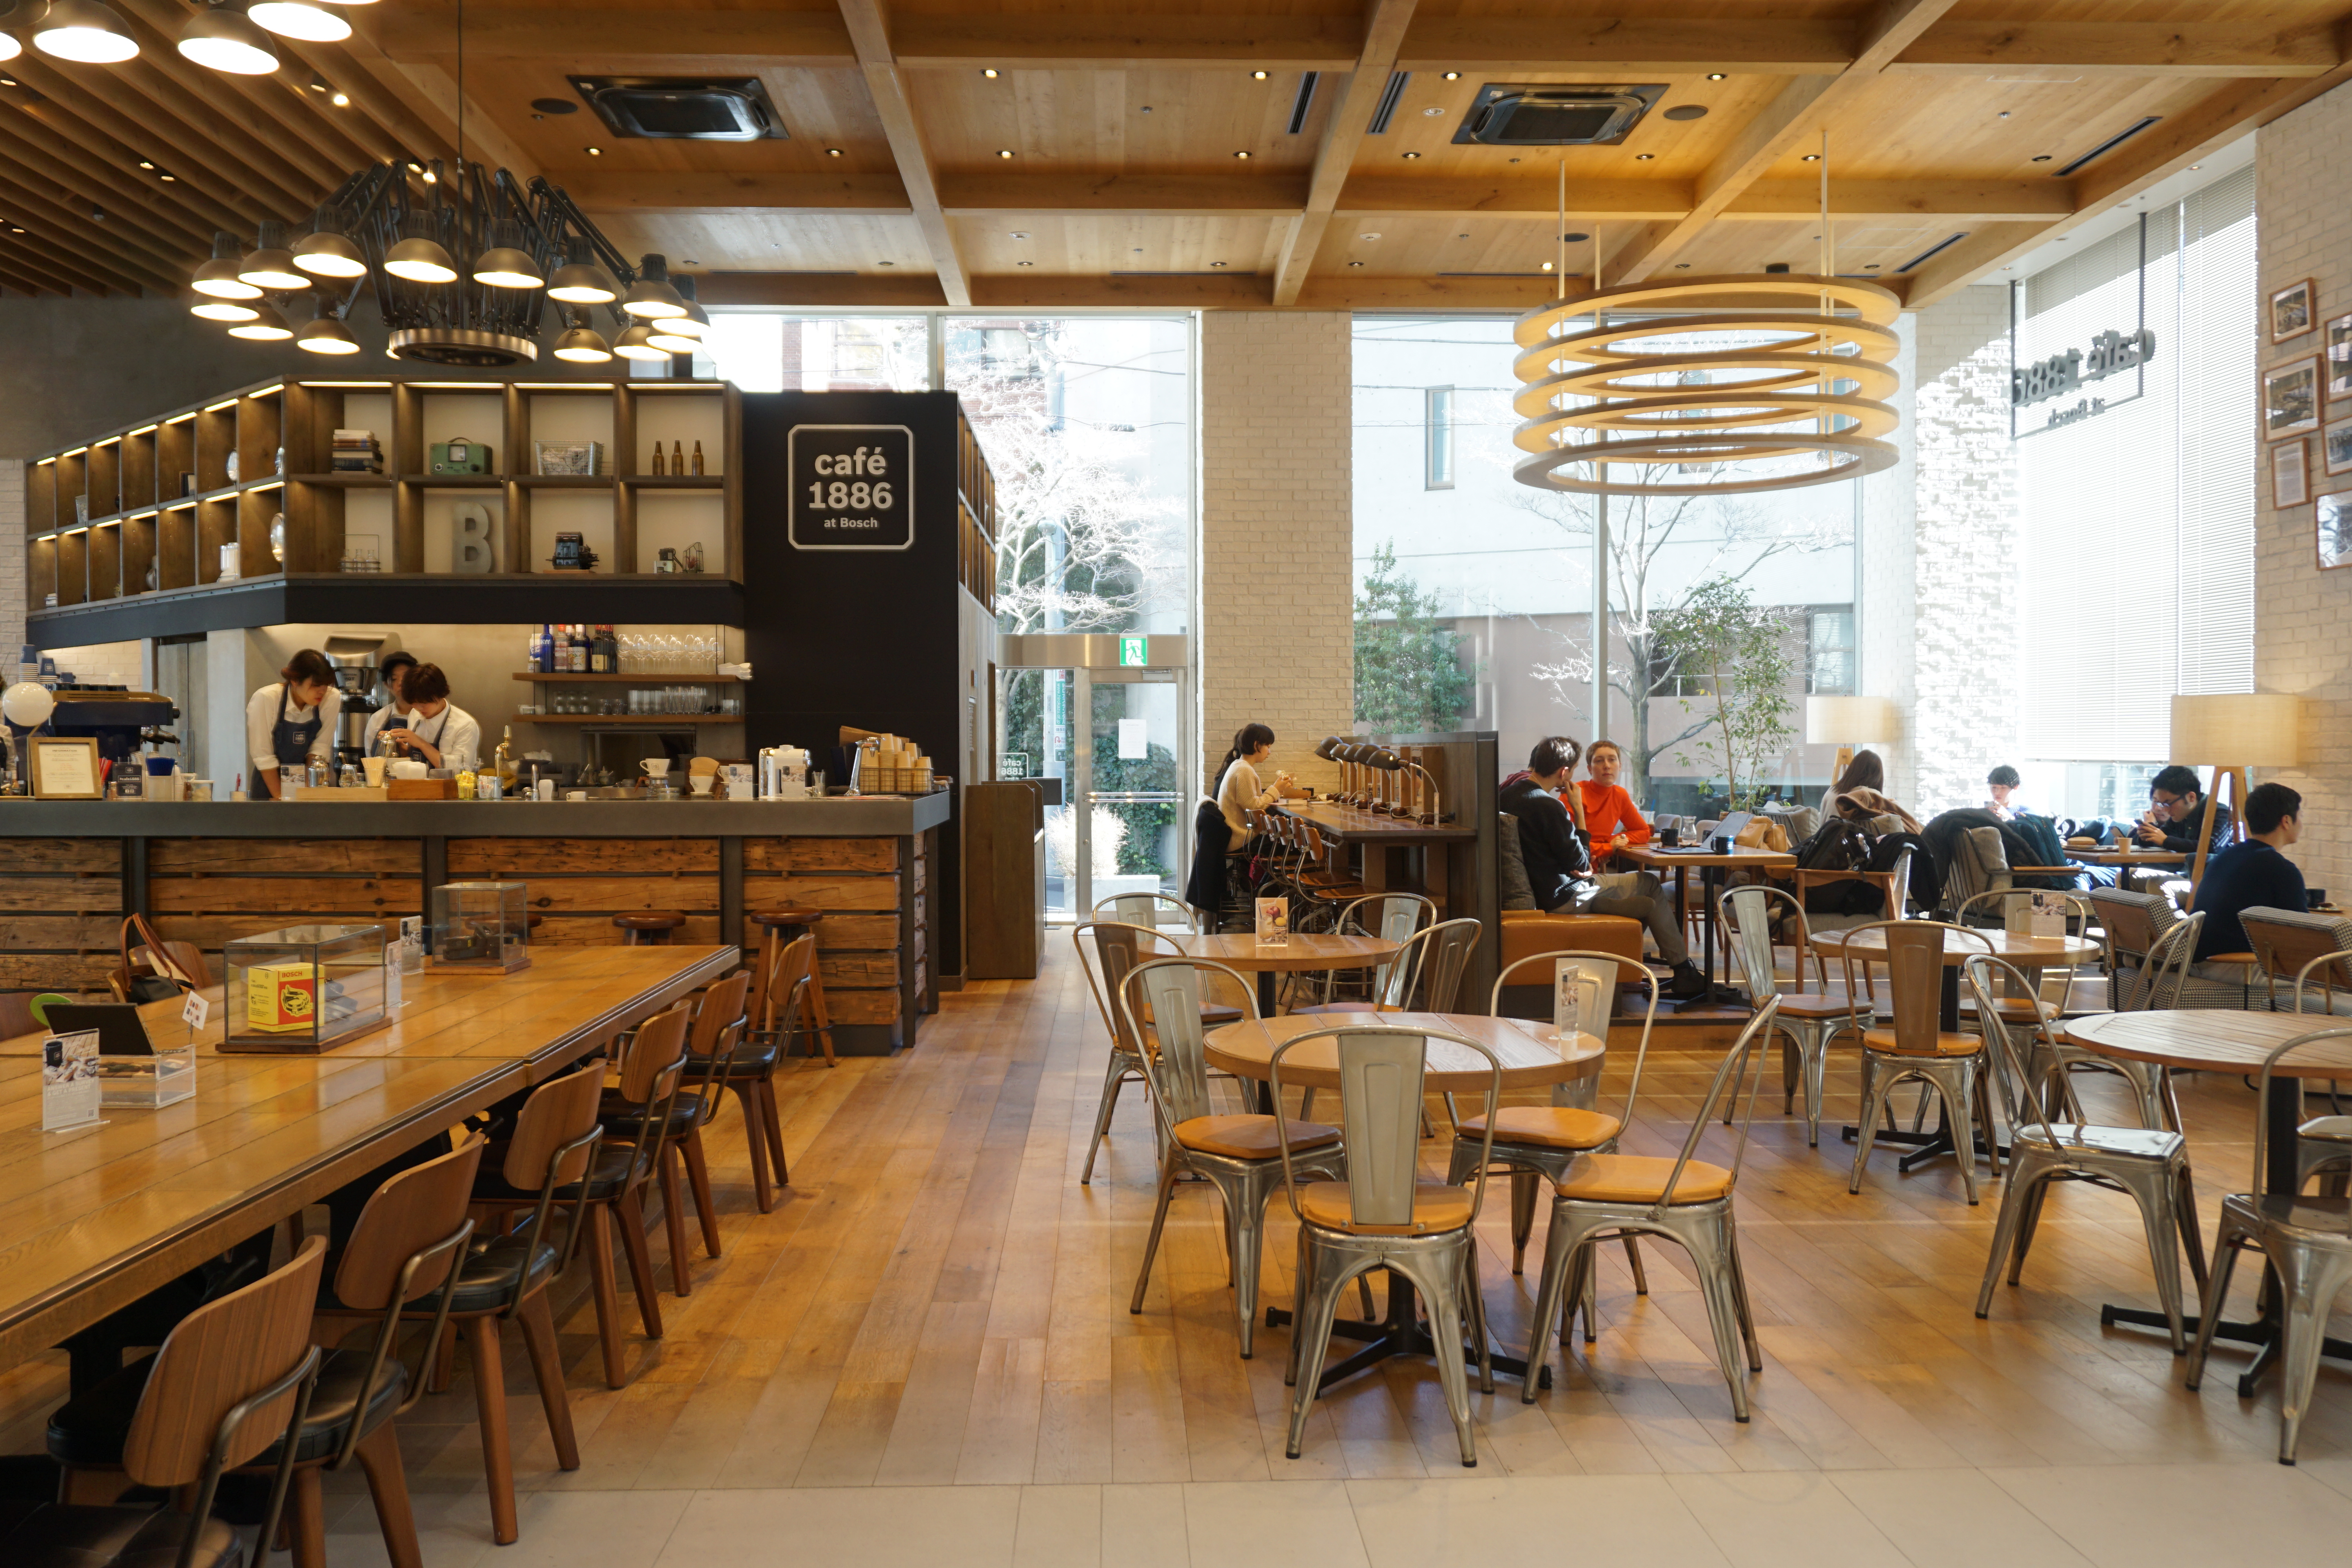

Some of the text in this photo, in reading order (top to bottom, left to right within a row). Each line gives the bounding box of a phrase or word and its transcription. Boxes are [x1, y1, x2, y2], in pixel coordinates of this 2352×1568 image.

[815, 446, 886, 475] café
[809, 482, 892, 509] 1886
[824, 517, 877, 527] at Bosch
[452, 502, 492, 573] B
